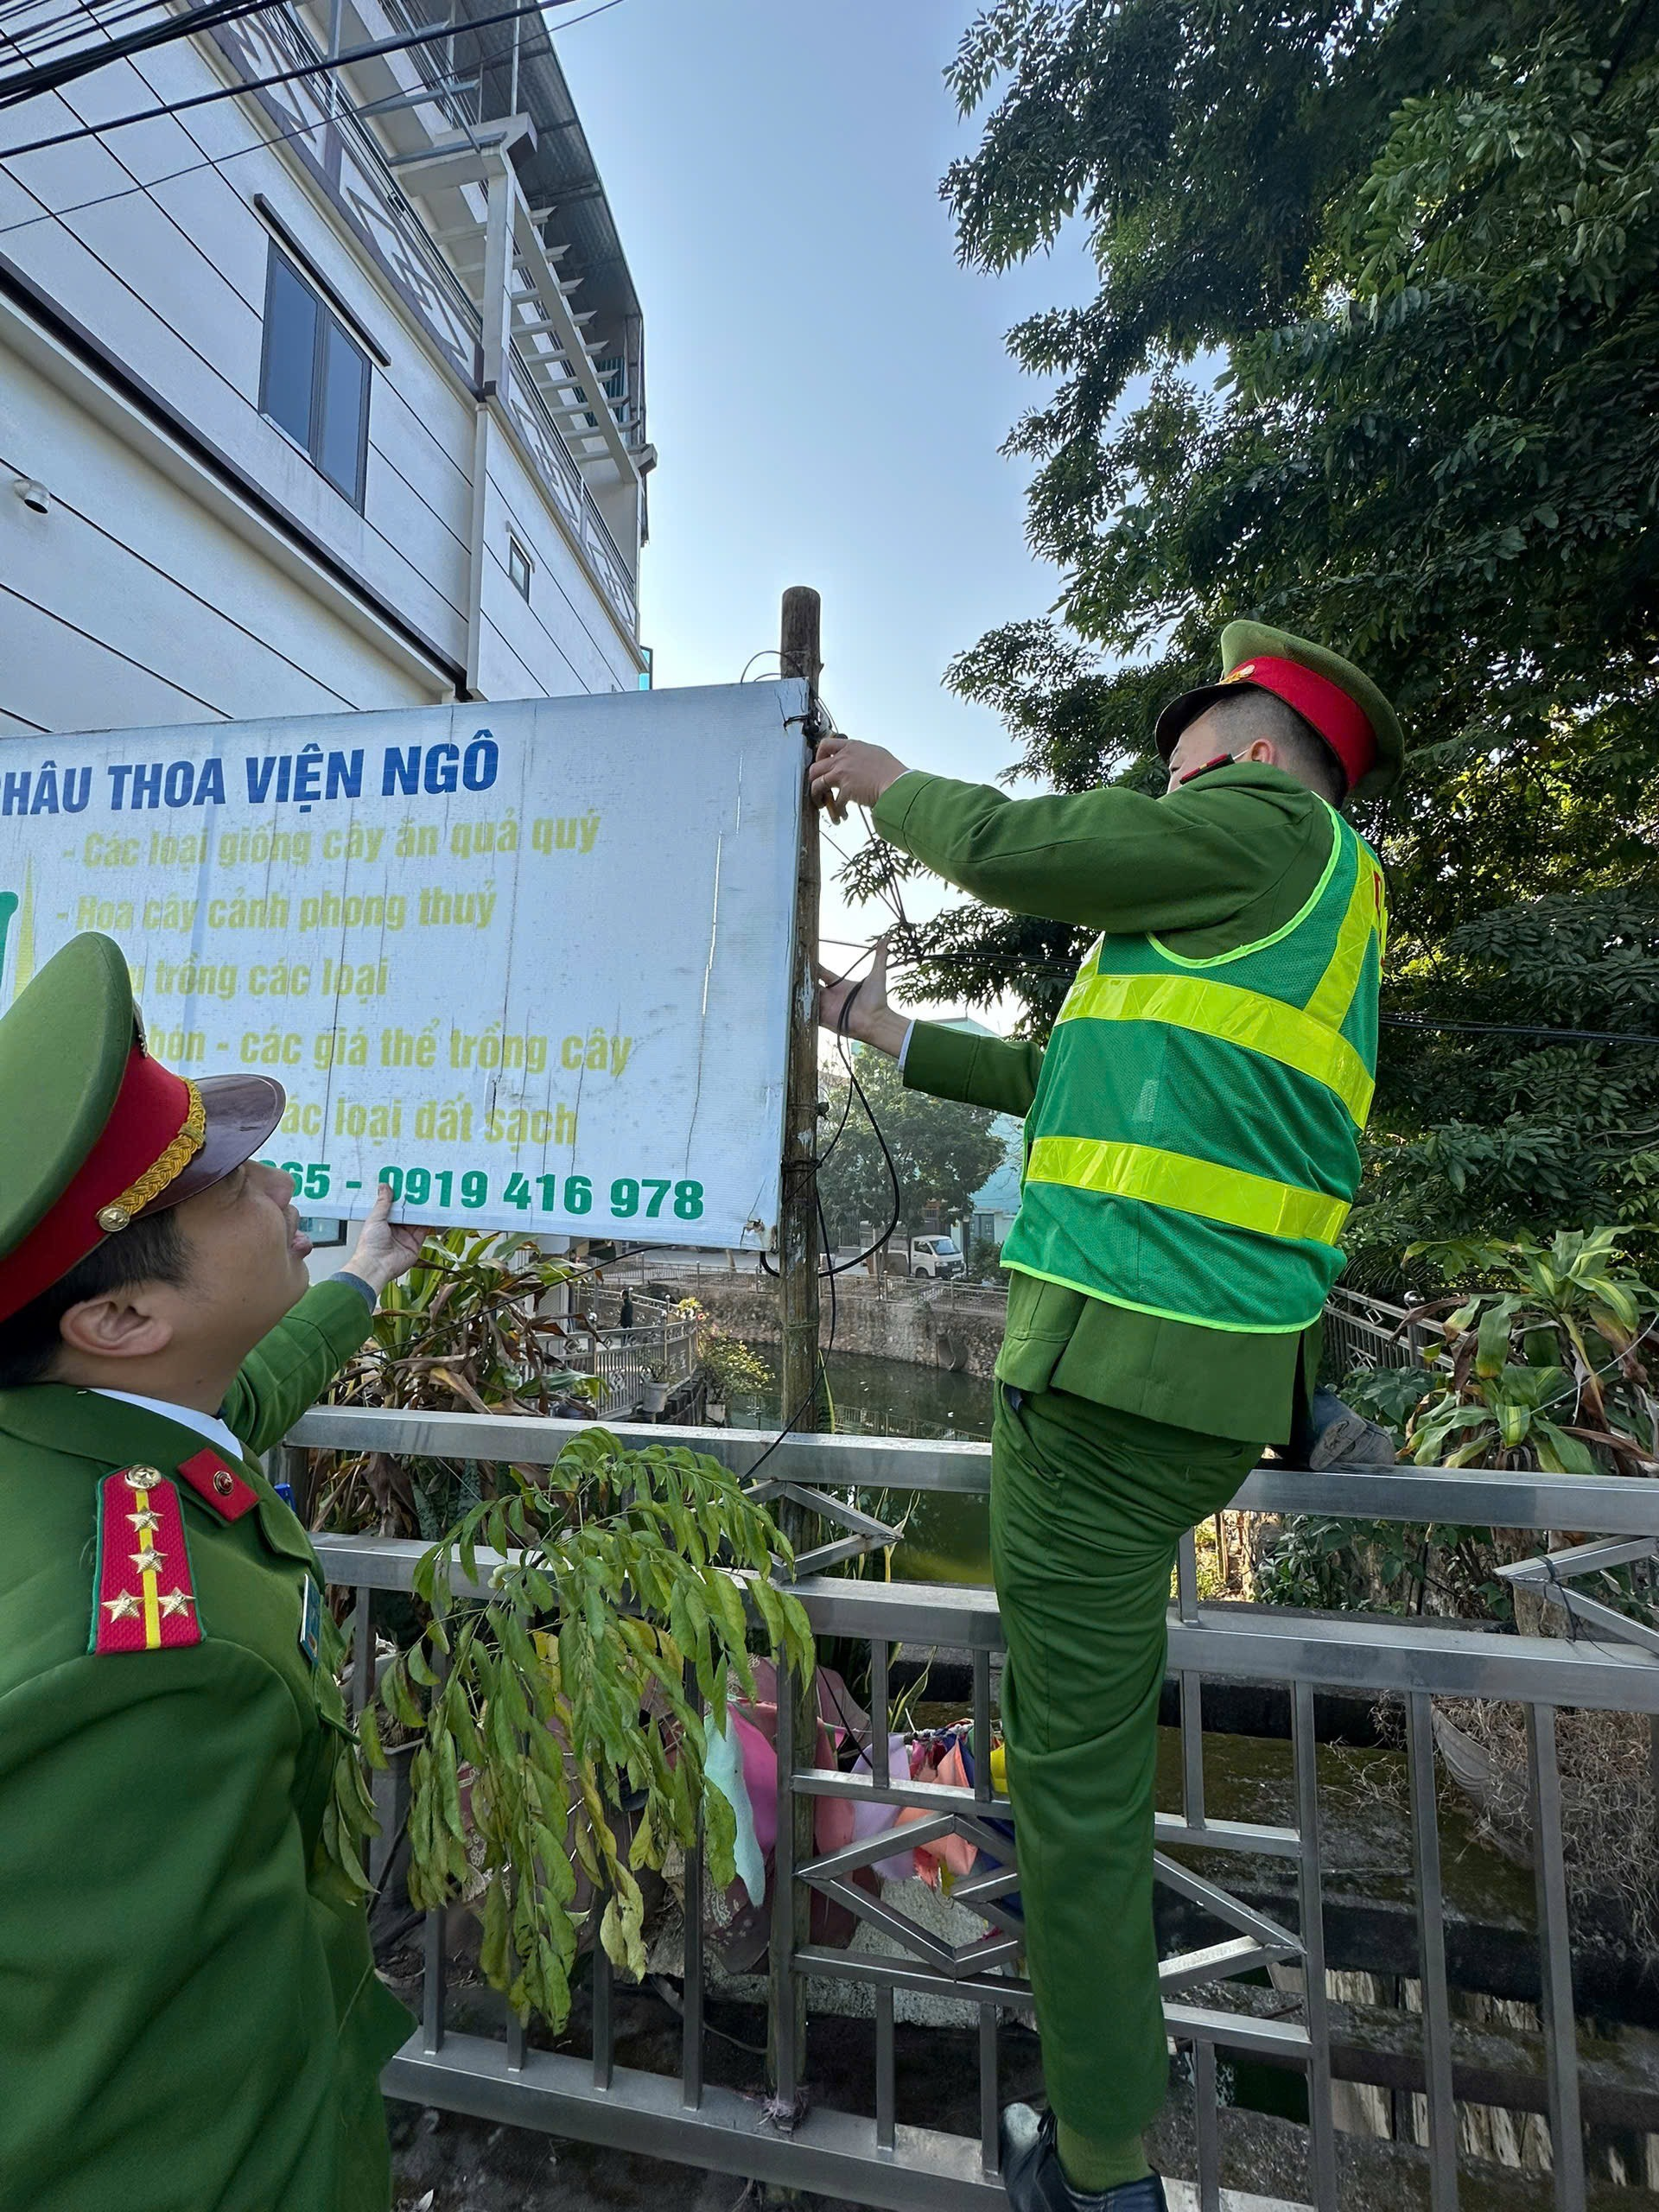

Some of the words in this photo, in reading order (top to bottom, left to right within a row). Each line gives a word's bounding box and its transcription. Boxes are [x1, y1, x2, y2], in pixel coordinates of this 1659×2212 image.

[0, 760, 92, 816] HÂU
[108, 758, 226, 810] THOA
[245, 743, 365, 813] VIỆN
[382, 729, 499, 797] NGÔ
[83, 830, 140, 869] Các
[149, 826, 209, 872] loại
[218, 817, 312, 868] giống
[322, 819, 385, 863] cây
[394, 816, 439, 858] ăn
[450, 806, 518, 860] quả
[75, 894, 133, 931] Hoa
[143, 892, 198, 933] cây
[207, 886, 289, 930] cảnh
[299, 888, 407, 932] phong
[418, 879, 497, 930] thuỷ
[154, 952, 238, 1001] trồng
[247, 957, 310, 996] các
[321, 957, 388, 1005] loại
[239, 1024, 303, 1065] các
[313, 1026, 369, 1071] giá
[380, 1018, 440, 1069] thể
[449, 1020, 548, 1074] trồng
[561, 1027, 633, 1077] cây
[278, 1095, 322, 1136] ác
[334, 1096, 403, 1147] loại
[414, 1091, 474, 1143] đất
[484, 1102, 578, 1154] sạch
[257, 1160, 332, 1200] 65
[378, 1166, 489, 1209] 0919
[503, 1172, 593, 1215] 416
[610, 1178, 704, 1220] 978
